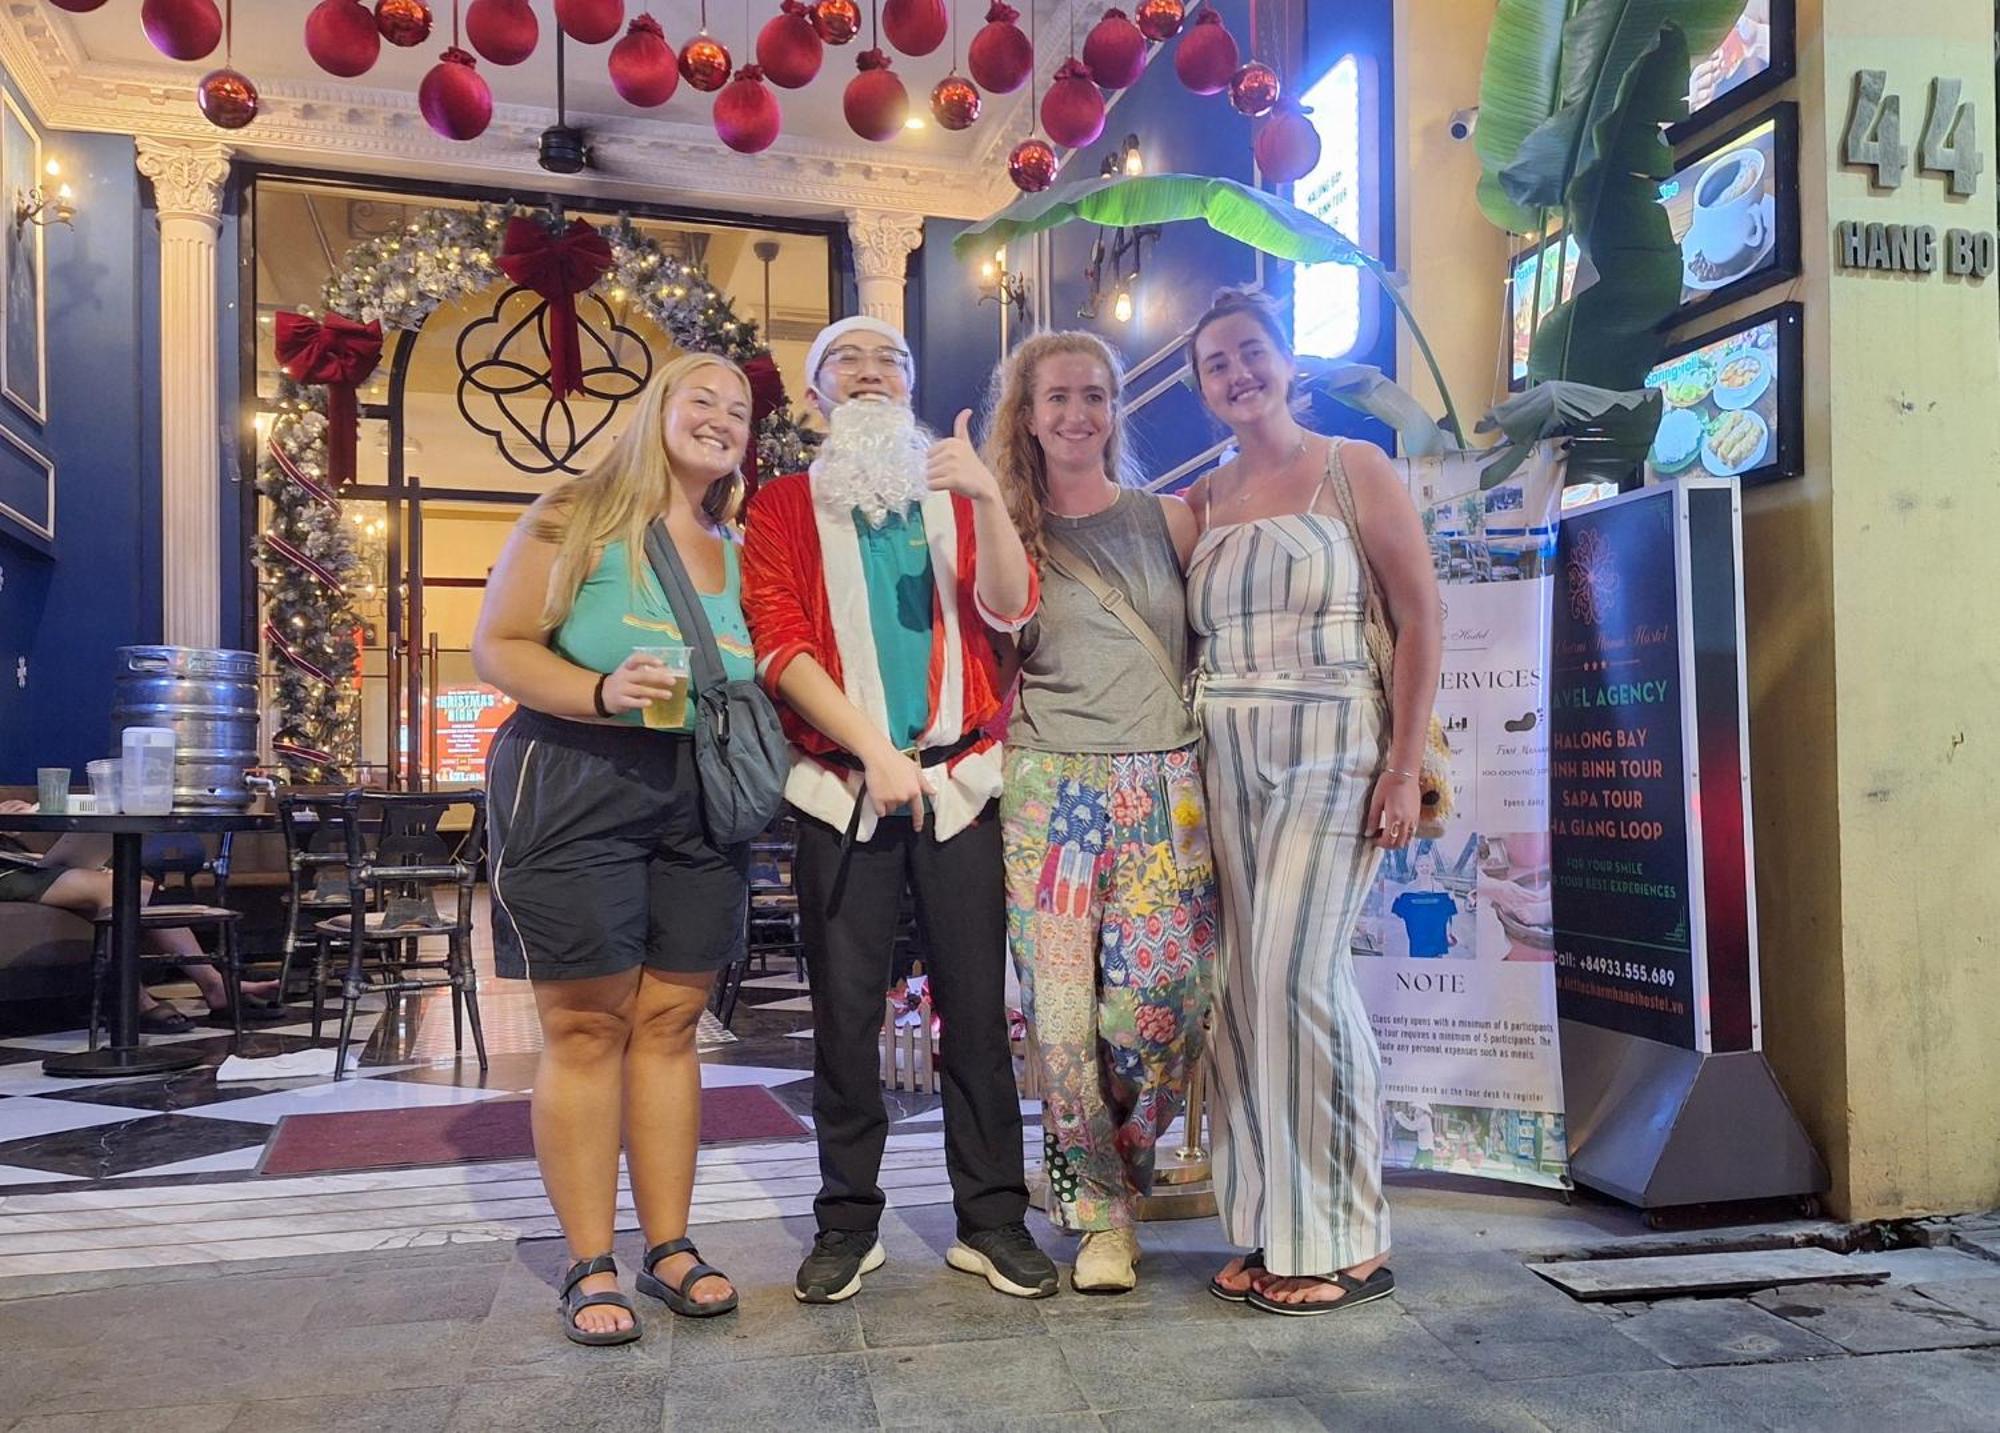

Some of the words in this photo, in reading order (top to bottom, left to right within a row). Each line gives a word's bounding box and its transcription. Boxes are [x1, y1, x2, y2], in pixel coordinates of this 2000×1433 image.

[1843, 69, 1983, 196] 44
[1839, 220, 1937, 274] HANG
[1946, 228, 1995, 277] BO
[1440, 669, 1540, 690] ERVICES
[1553, 686, 1591, 708] AVEL
[1596, 679, 1667, 706] AGENCY
[1553, 730, 1613, 750] HALONG
[1616, 728, 1647, 748] BAY
[1552, 761, 1577, 778] INH
[1582, 760, 1617, 779] BINH
[1620, 759, 1663, 779] TOUR
[1562, 790, 1599, 808] SAPA
[1602, 790, 1643, 809] TOUR
[1570, 819, 1616, 838] GIANG
[1620, 821, 1664, 840] LOOP
[1587, 859, 1613, 872] YOUR
[1615, 861, 1643, 876] SMILE
[1609, 879, 1677, 899] EXPERIENCES
[1580, 954, 1676, 987] +84933.555.689
[1396, 972, 1465, 994] NOTE
[1372, 1013, 1391, 1025] Class
[1393, 1014, 1408, 1027] only
[1433, 1017, 1449, 1028] with
[1458, 1019, 1492, 1030] minimum
[1384, 1027, 1399, 1038] tour
[1438, 1031, 1472, 1042] minimum
[1396, 1043, 1410, 1053] any
[1411, 1043, 1442, 1054] personal
[1444, 1046, 1478, 1057] expenses
[1480, 1047, 1497, 1058] such
[1385, 1083, 1419, 1094] reception
[1421, 1085, 1437, 1095] desk
[1450, 1087, 1462, 1097] the
[1464, 1088, 1480, 1098] tour
[1483, 1090, 1500, 1099] desk
[1513, 1092, 1544, 1103] register
